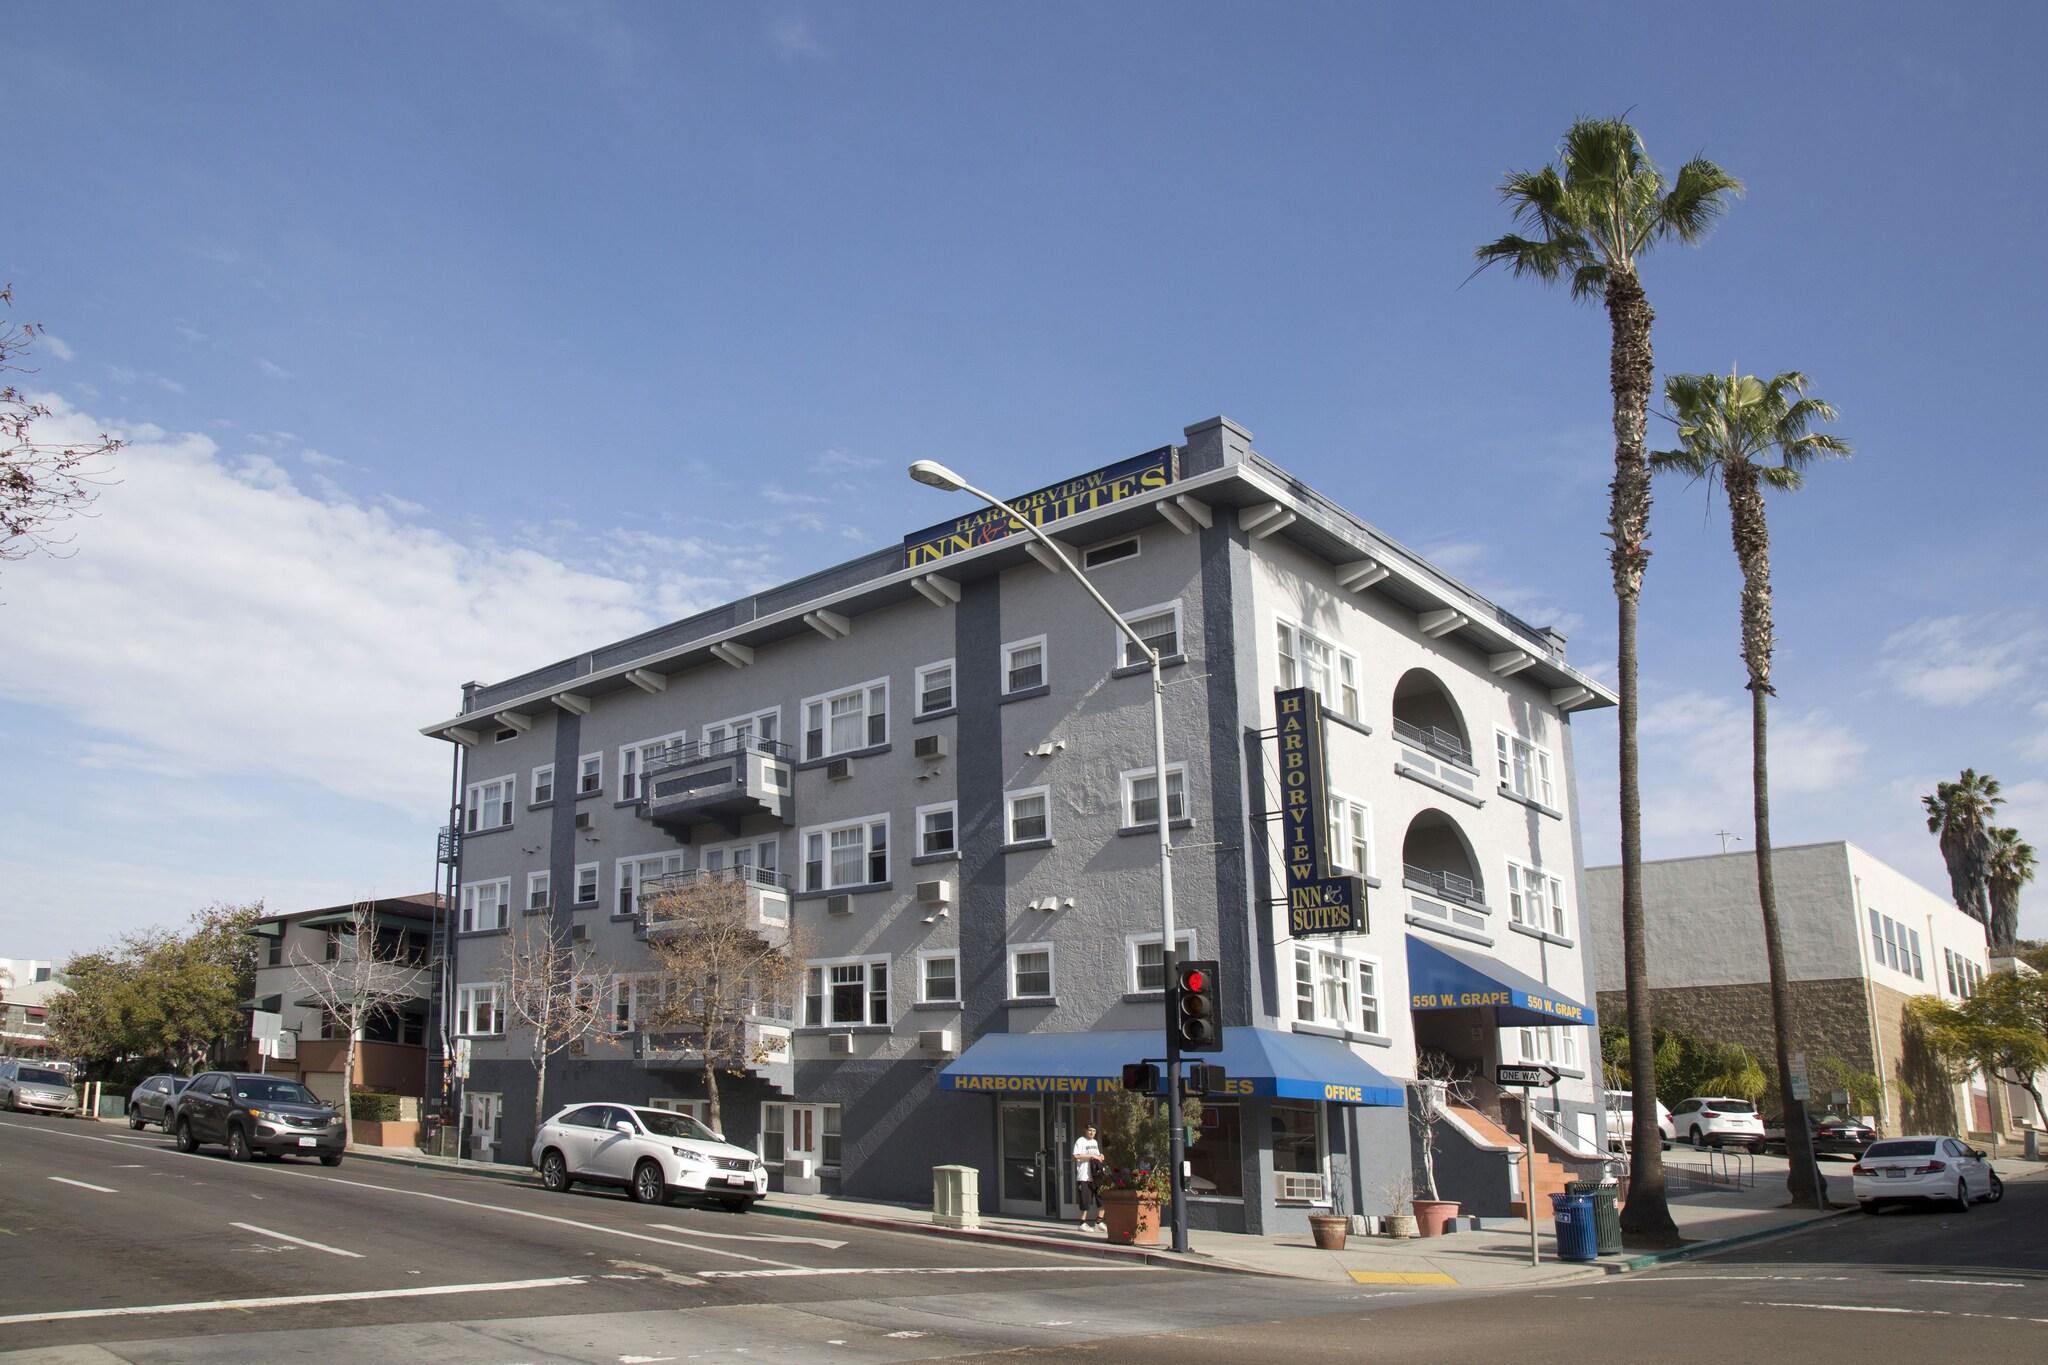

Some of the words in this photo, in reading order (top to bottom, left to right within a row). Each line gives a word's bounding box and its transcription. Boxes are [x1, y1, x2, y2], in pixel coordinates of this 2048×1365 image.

[956, 471, 1106, 532] HARORVIEW
[907, 528, 975, 569] INN
[976, 520, 1007, 545] &
[1281, 698, 1313, 880] HARBORVIEW
[1291, 886, 1321, 909] INN
[1324, 885, 1343, 905] &
[1293, 904, 1351, 931] SUITES
[1413, 994, 1437, 1008] 550
[1440, 993, 1457, 1006] W.
[1461, 991, 1510, 1006] GRAPE
[1527, 995, 1543, 1010] 550
[1543, 1000, 1554, 1013] W.
[1555, 1004, 1582, 1020] GRAPE
[955, 1075, 1088, 1092] HARBORVIEW
[1502, 1071, 1519, 1080] ONE
[1522, 1072, 1540, 1081] WAY
[1325, 1084, 1362, 1102] OFFICE
